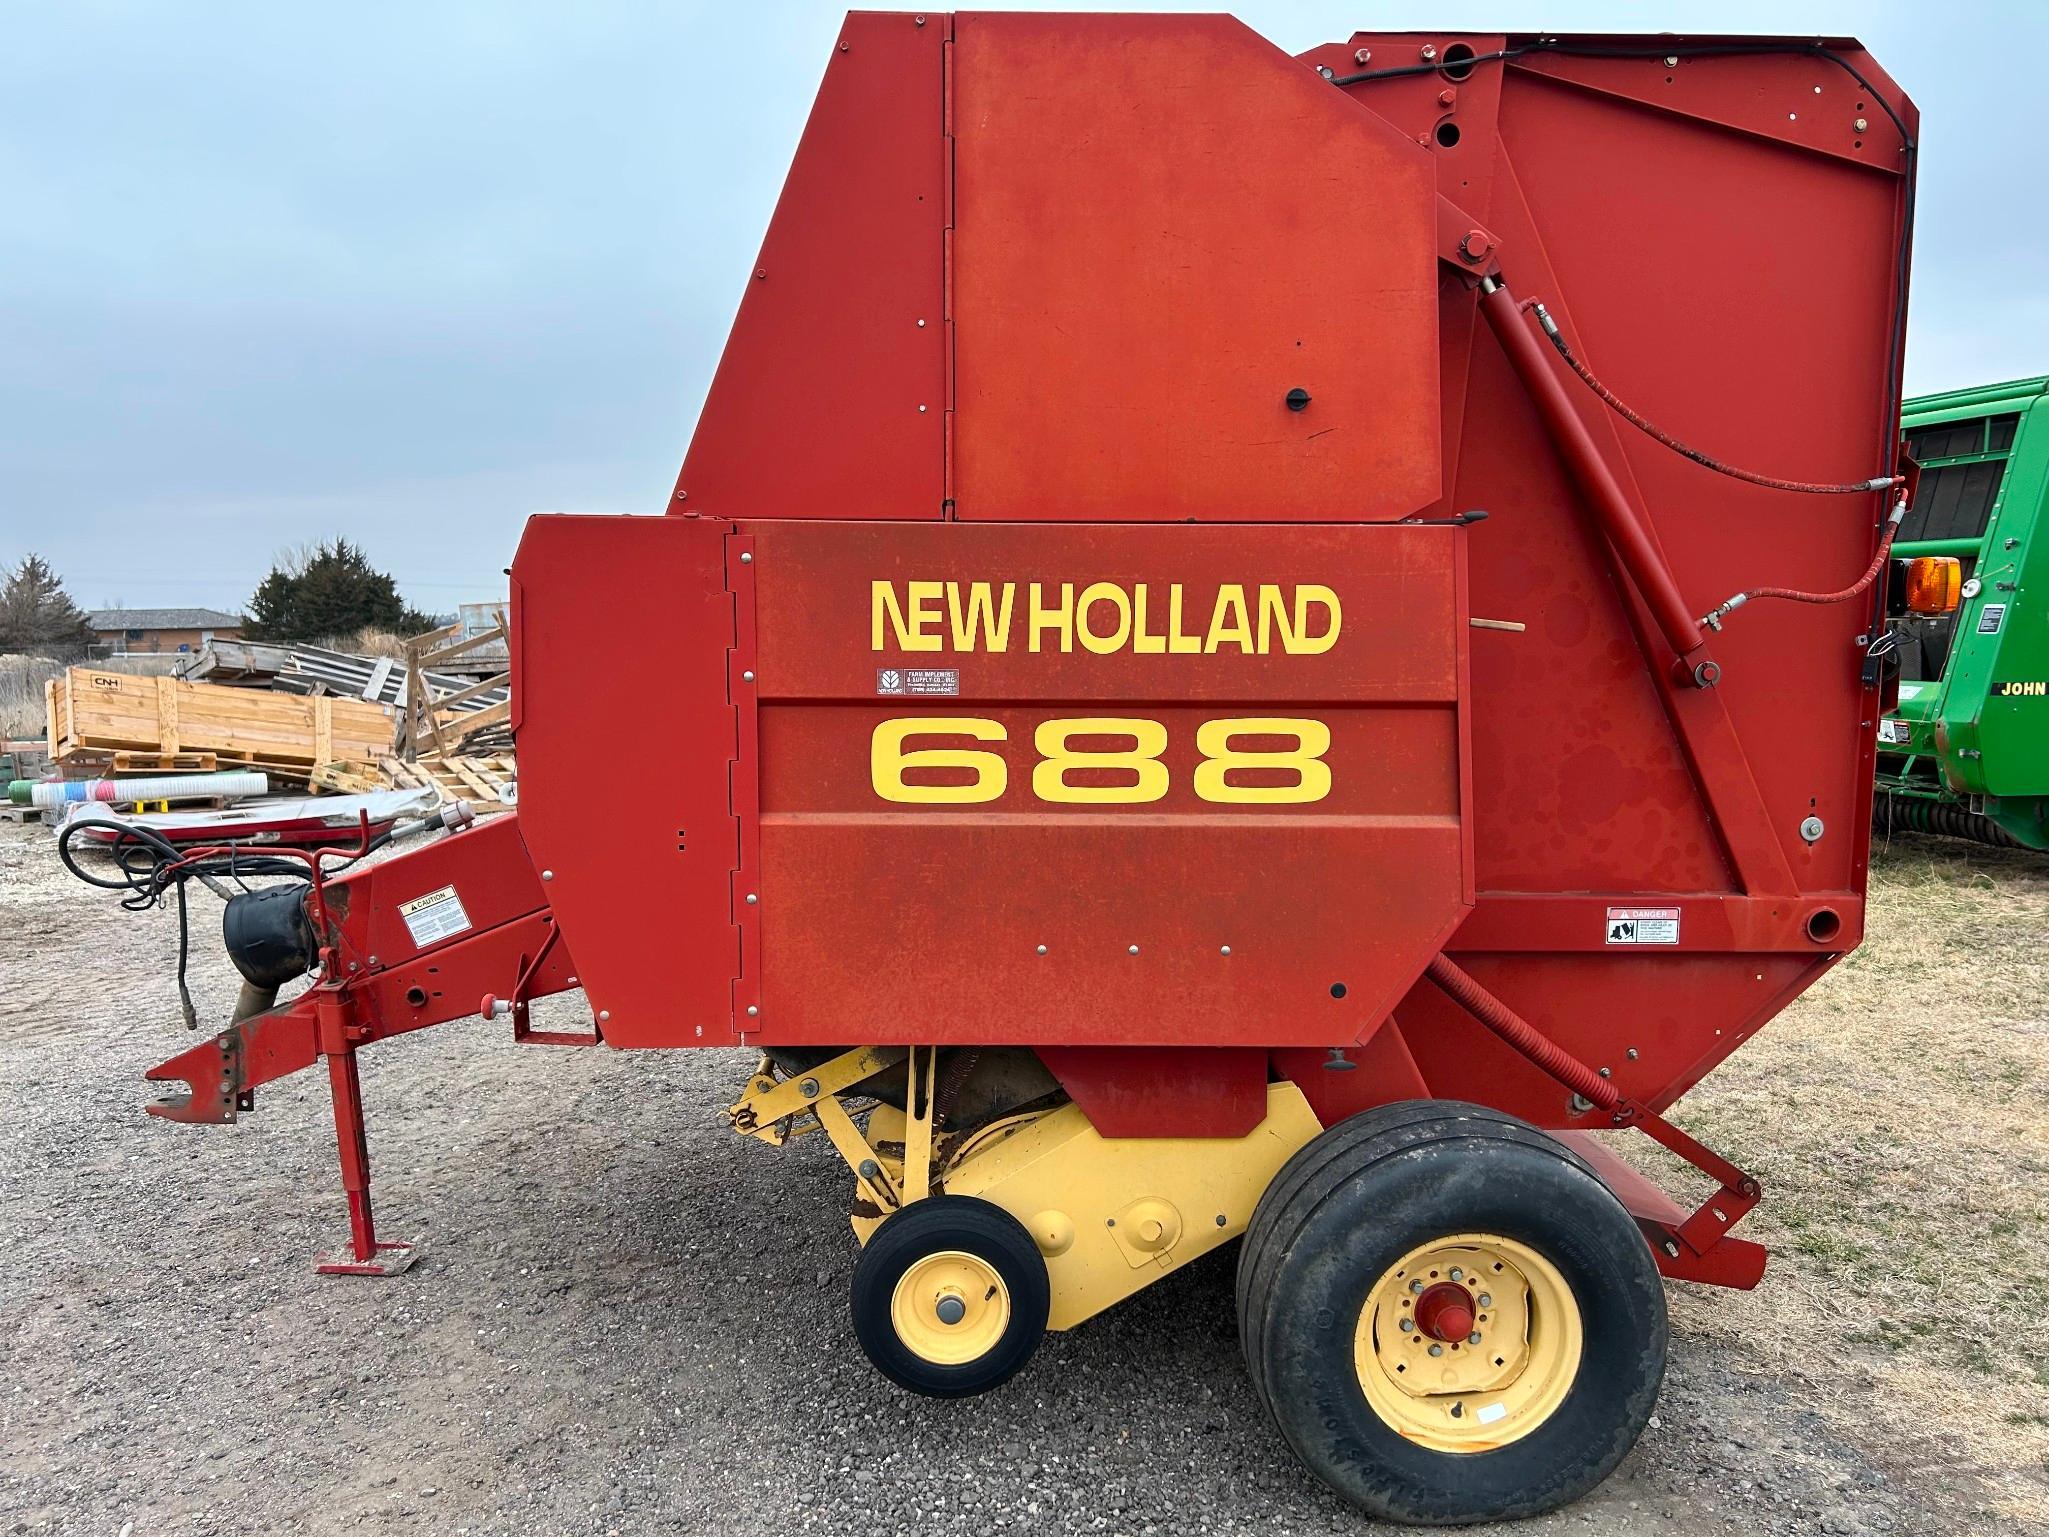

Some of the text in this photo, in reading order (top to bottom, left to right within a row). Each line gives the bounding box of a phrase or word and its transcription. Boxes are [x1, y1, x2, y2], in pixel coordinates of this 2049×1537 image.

[871, 580, 1343, 655] NEW HOLLAND
[95, 678, 118, 687] CNH
[2001, 682, 2046, 696] JOHN
[871, 717, 1332, 804] 688
[417, 892, 446, 907] CAUTION
[1632, 910, 1667, 918] DANGER
